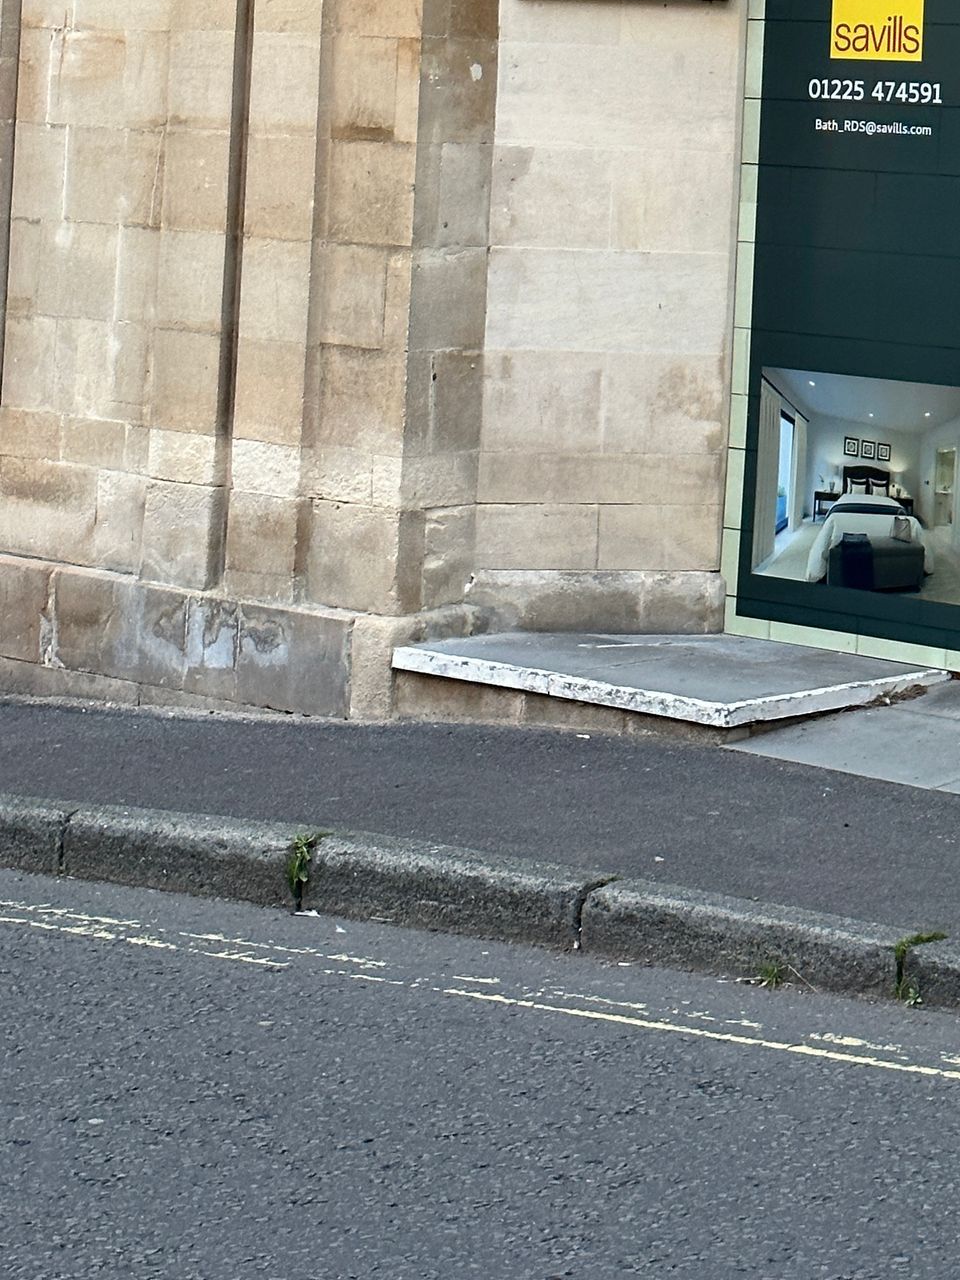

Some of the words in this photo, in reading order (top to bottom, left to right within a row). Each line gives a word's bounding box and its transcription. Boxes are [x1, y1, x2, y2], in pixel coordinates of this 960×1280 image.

[834, 15, 920, 54] savills
[808, 78, 865, 101] 01225
[871, 81, 943, 104] 474591
[815, 118, 932, 136] Bath_RDS@savills.com
